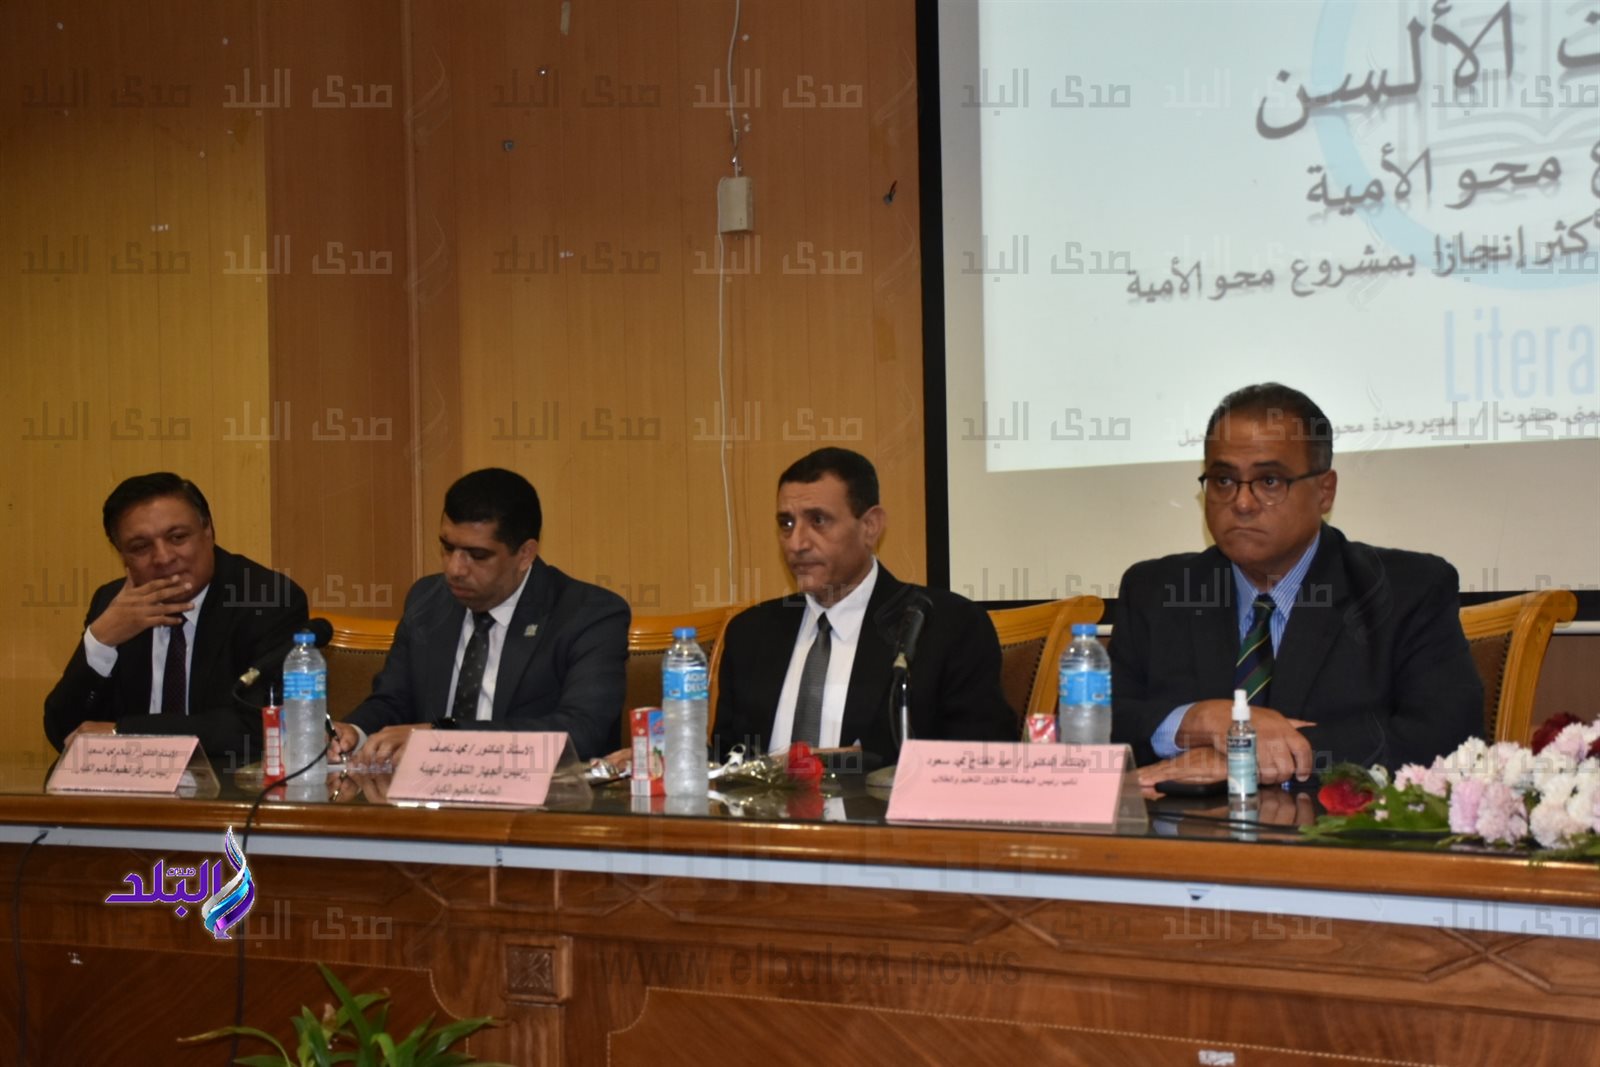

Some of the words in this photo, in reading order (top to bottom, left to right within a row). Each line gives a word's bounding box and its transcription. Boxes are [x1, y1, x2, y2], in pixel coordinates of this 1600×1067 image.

[1305, 142, 1433, 216] الأمية
[1444, 155, 1563, 210] محو
[1126, 257, 1203, 302] الأمية
[1206, 267, 1276, 300] محو
[1290, 245, 1417, 297] بمشروع
